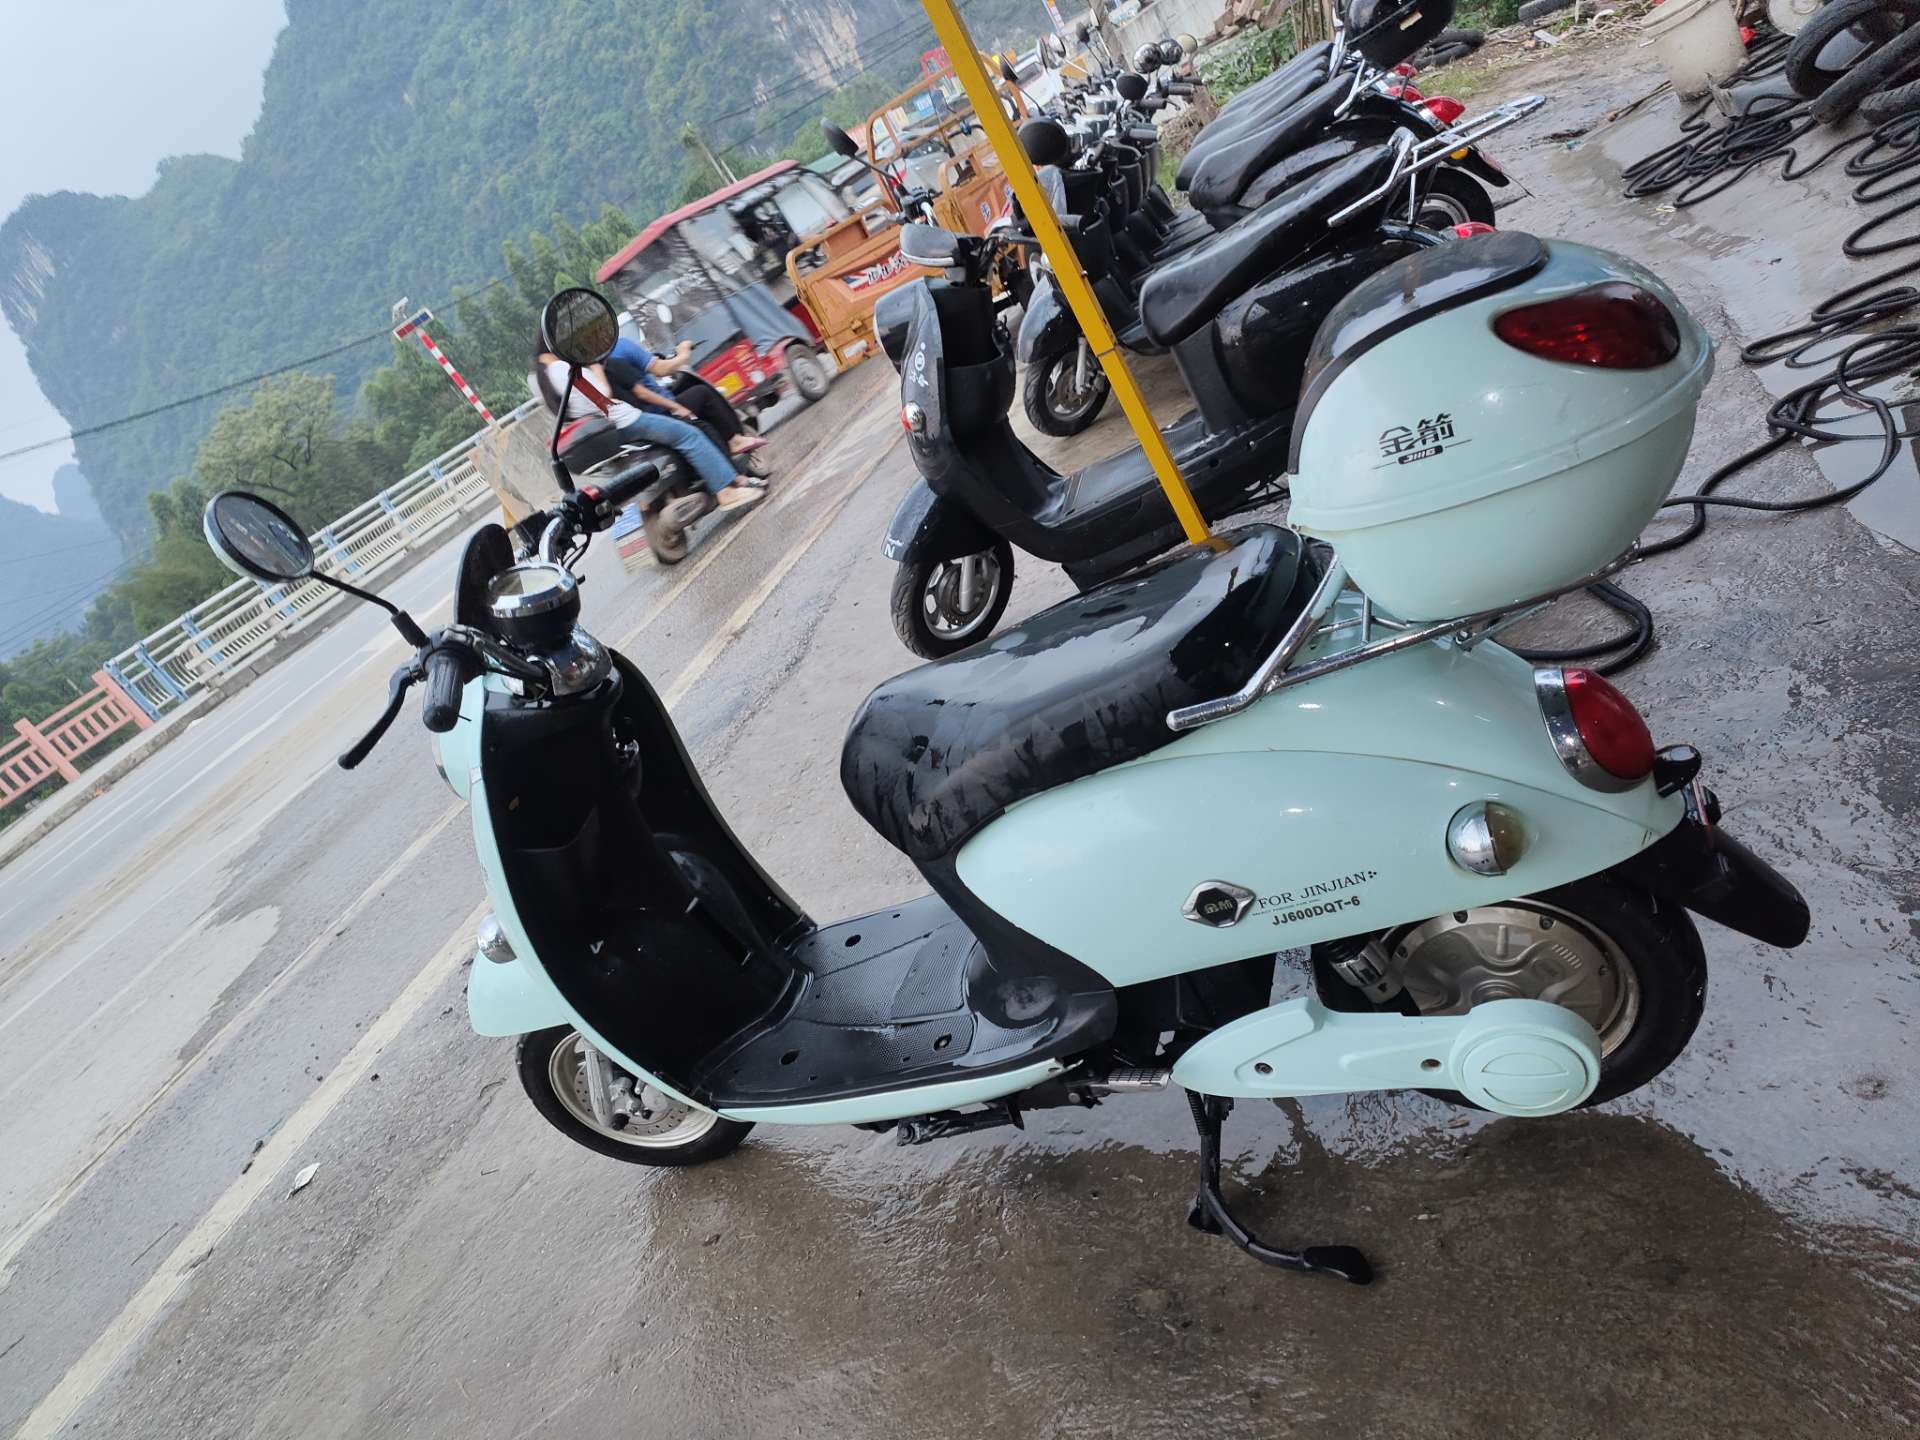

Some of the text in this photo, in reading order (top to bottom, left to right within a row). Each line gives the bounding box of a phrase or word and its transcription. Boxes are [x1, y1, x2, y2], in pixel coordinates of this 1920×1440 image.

[1258, 892, 1295, 909] FOR
[1300, 871, 1367, 899] JINJIAN
[1272, 895, 1361, 926] JJ600DQT-6
